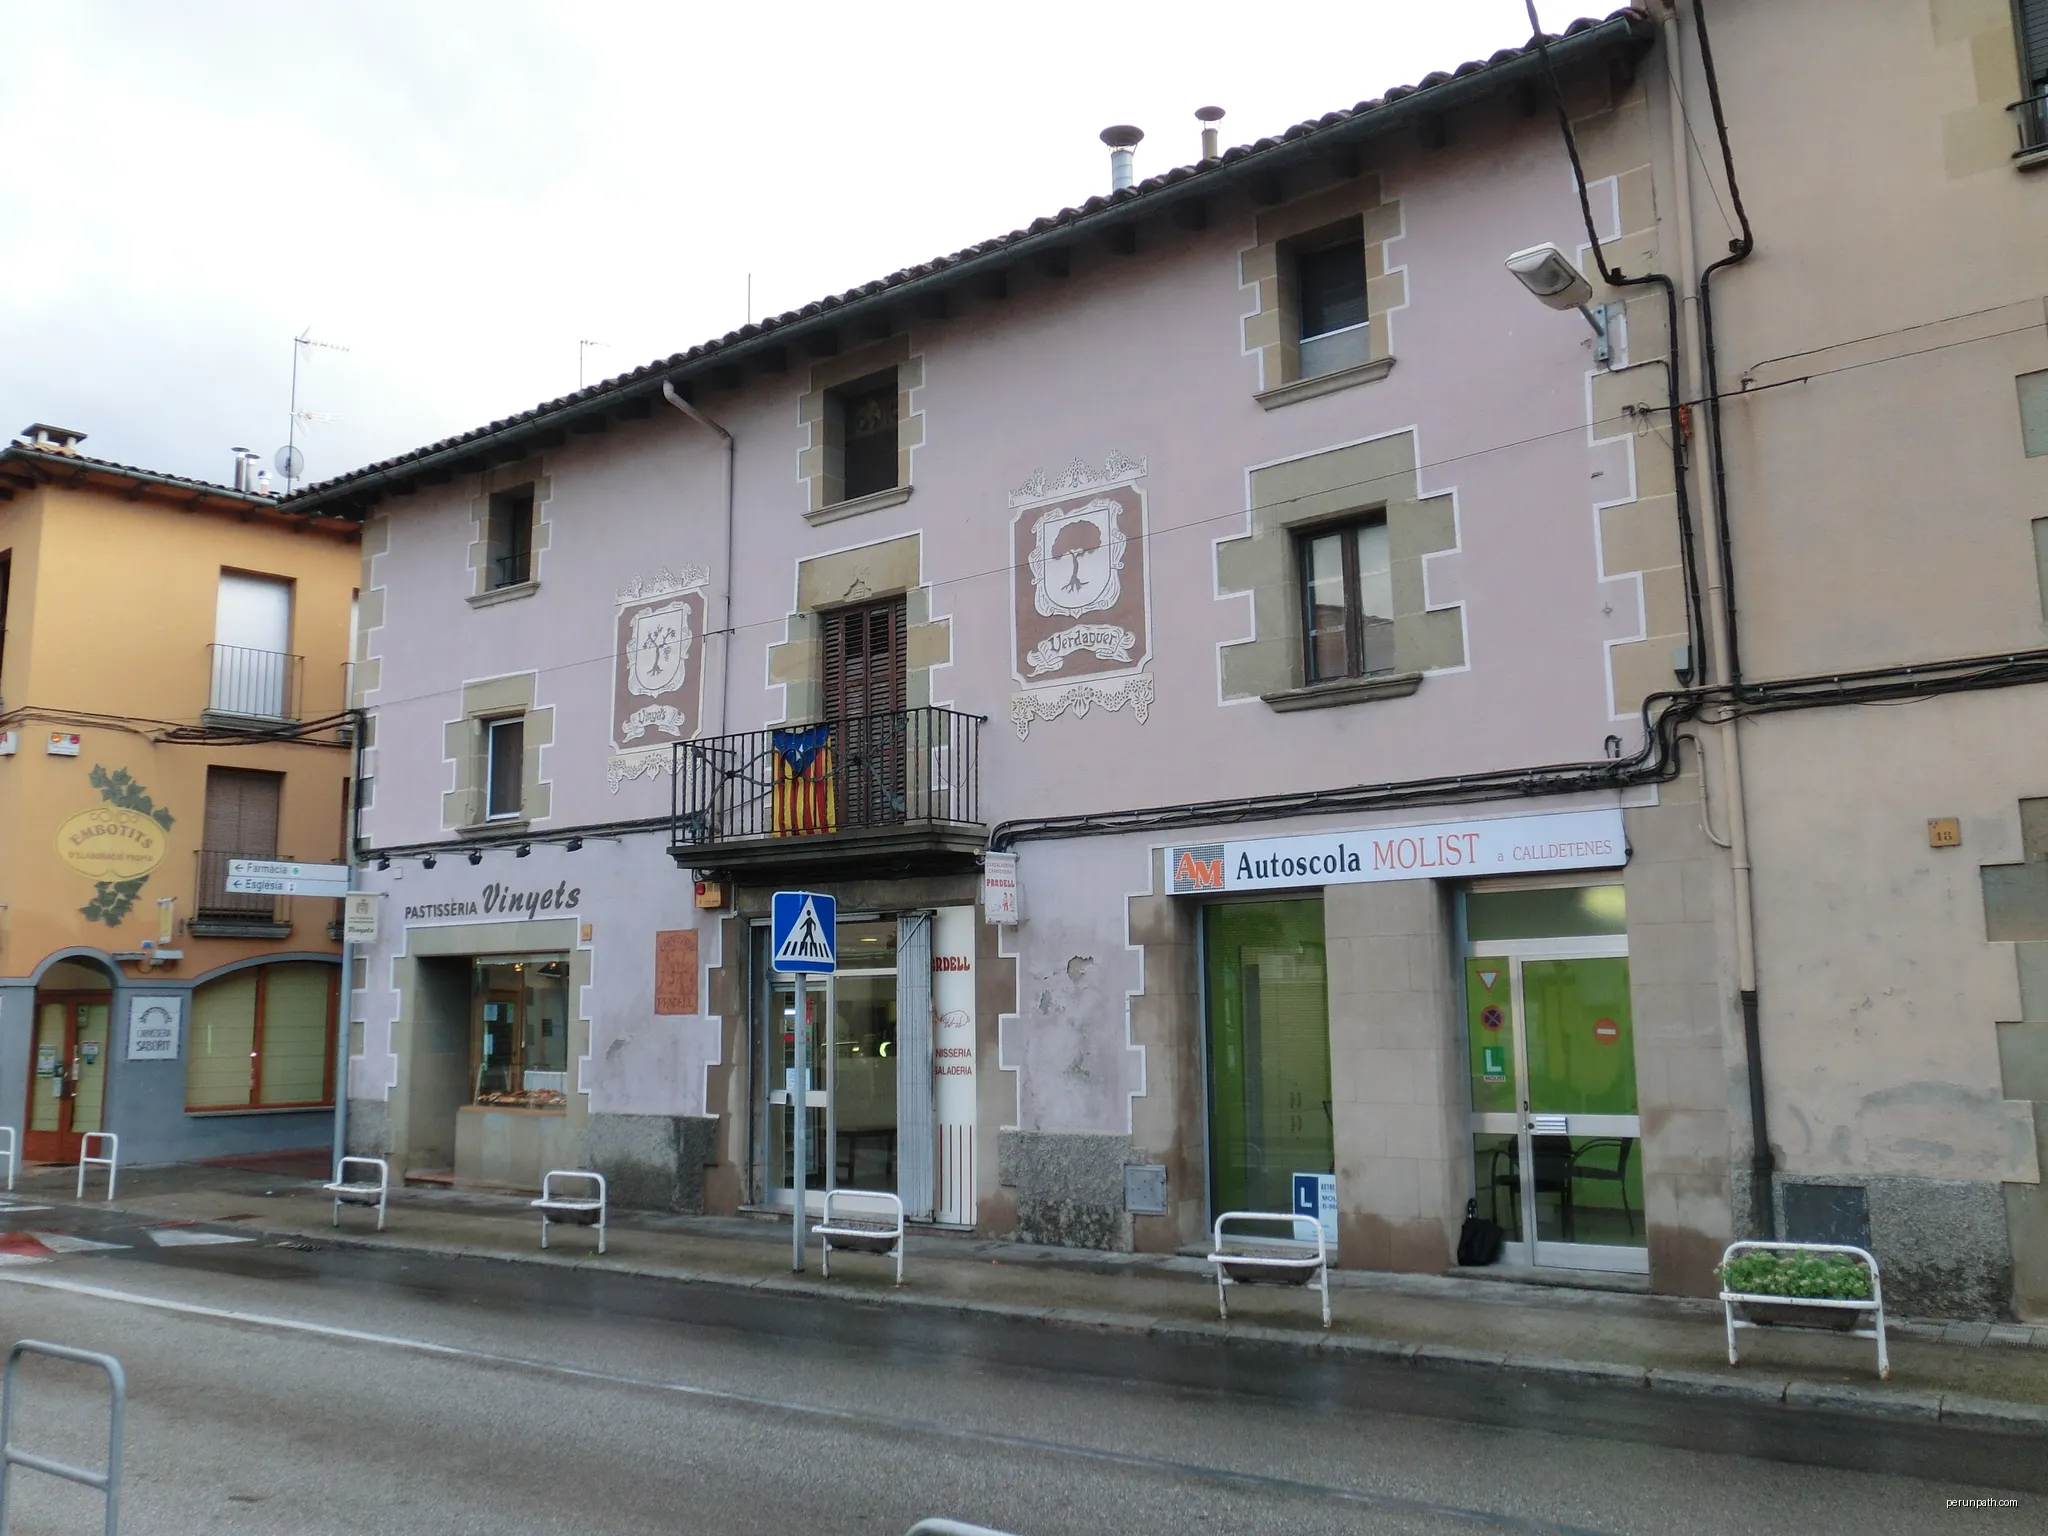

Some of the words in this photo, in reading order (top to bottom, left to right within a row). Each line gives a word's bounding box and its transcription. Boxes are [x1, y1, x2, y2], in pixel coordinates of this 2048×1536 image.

[1049, 629, 1116, 652] Verdaguer
[70, 824, 152, 848] EMBOTITS
[1236, 844, 1361, 880] Autoscola
[1373, 832, 1480, 870] MOLIST
[1497, 853, 1505, 862] a
[1513, 839, 1613, 861] CALLDETENES
[245, 879, 283, 891] Església
[986, 878, 1016, 888] PRADELL
[482, 880, 581, 919] Vinyets
[1485, 1049, 1502, 1072] L
[1300, 1187, 1313, 1208] L
